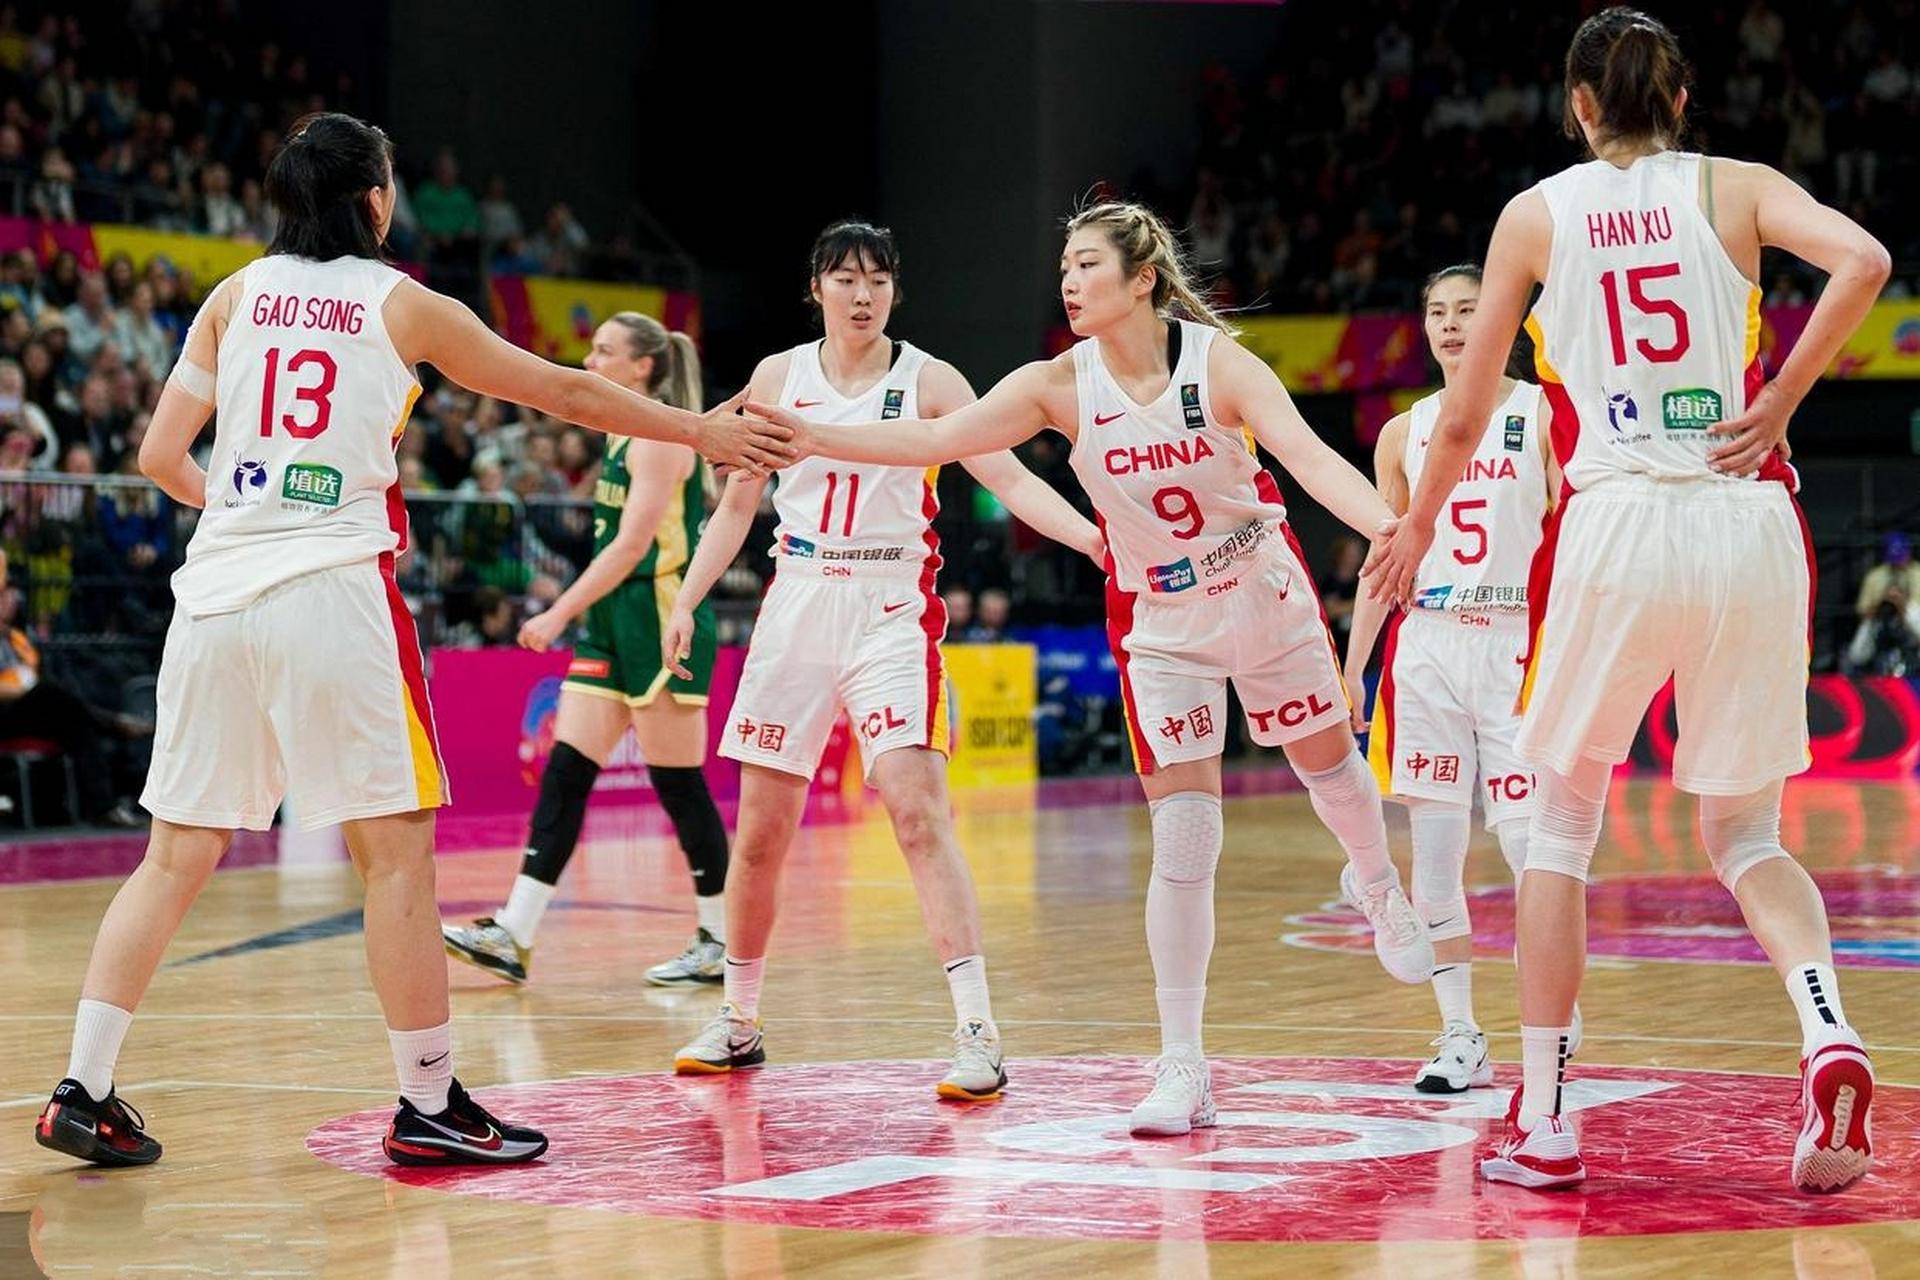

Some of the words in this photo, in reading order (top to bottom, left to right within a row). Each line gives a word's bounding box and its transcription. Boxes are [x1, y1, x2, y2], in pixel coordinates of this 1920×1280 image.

[1587, 210, 1636, 248] HAN
[1640, 206, 1673, 245] XU
[252, 293, 299, 328] GAO
[302, 297, 366, 336] SONG
[1599, 262, 1691, 367] 15
[259, 347, 338, 440] 13
[1666, 395, 1720, 421] 植选
[1104, 435, 1215, 476] CHINA
[1459, 457, 1517, 483] INA
[287, 467, 338, 497] 植选
[819, 471, 860, 538] 11
[1151, 486, 1206, 541] 9
[1451, 499, 1488, 566] 5
[821, 566, 852, 577] CHN
[1206, 578, 1240, 597] CHN
[1460, 614, 1491, 627] CHN
[1160, 704, 1214, 746] 中国
[1247, 693, 1334, 733] TCL
[736, 717, 786, 753] 中国
[1406, 751, 1460, 784] 中国
[1487, 773, 1537, 803] TC
[56, 1084, 75, 1095] GT
